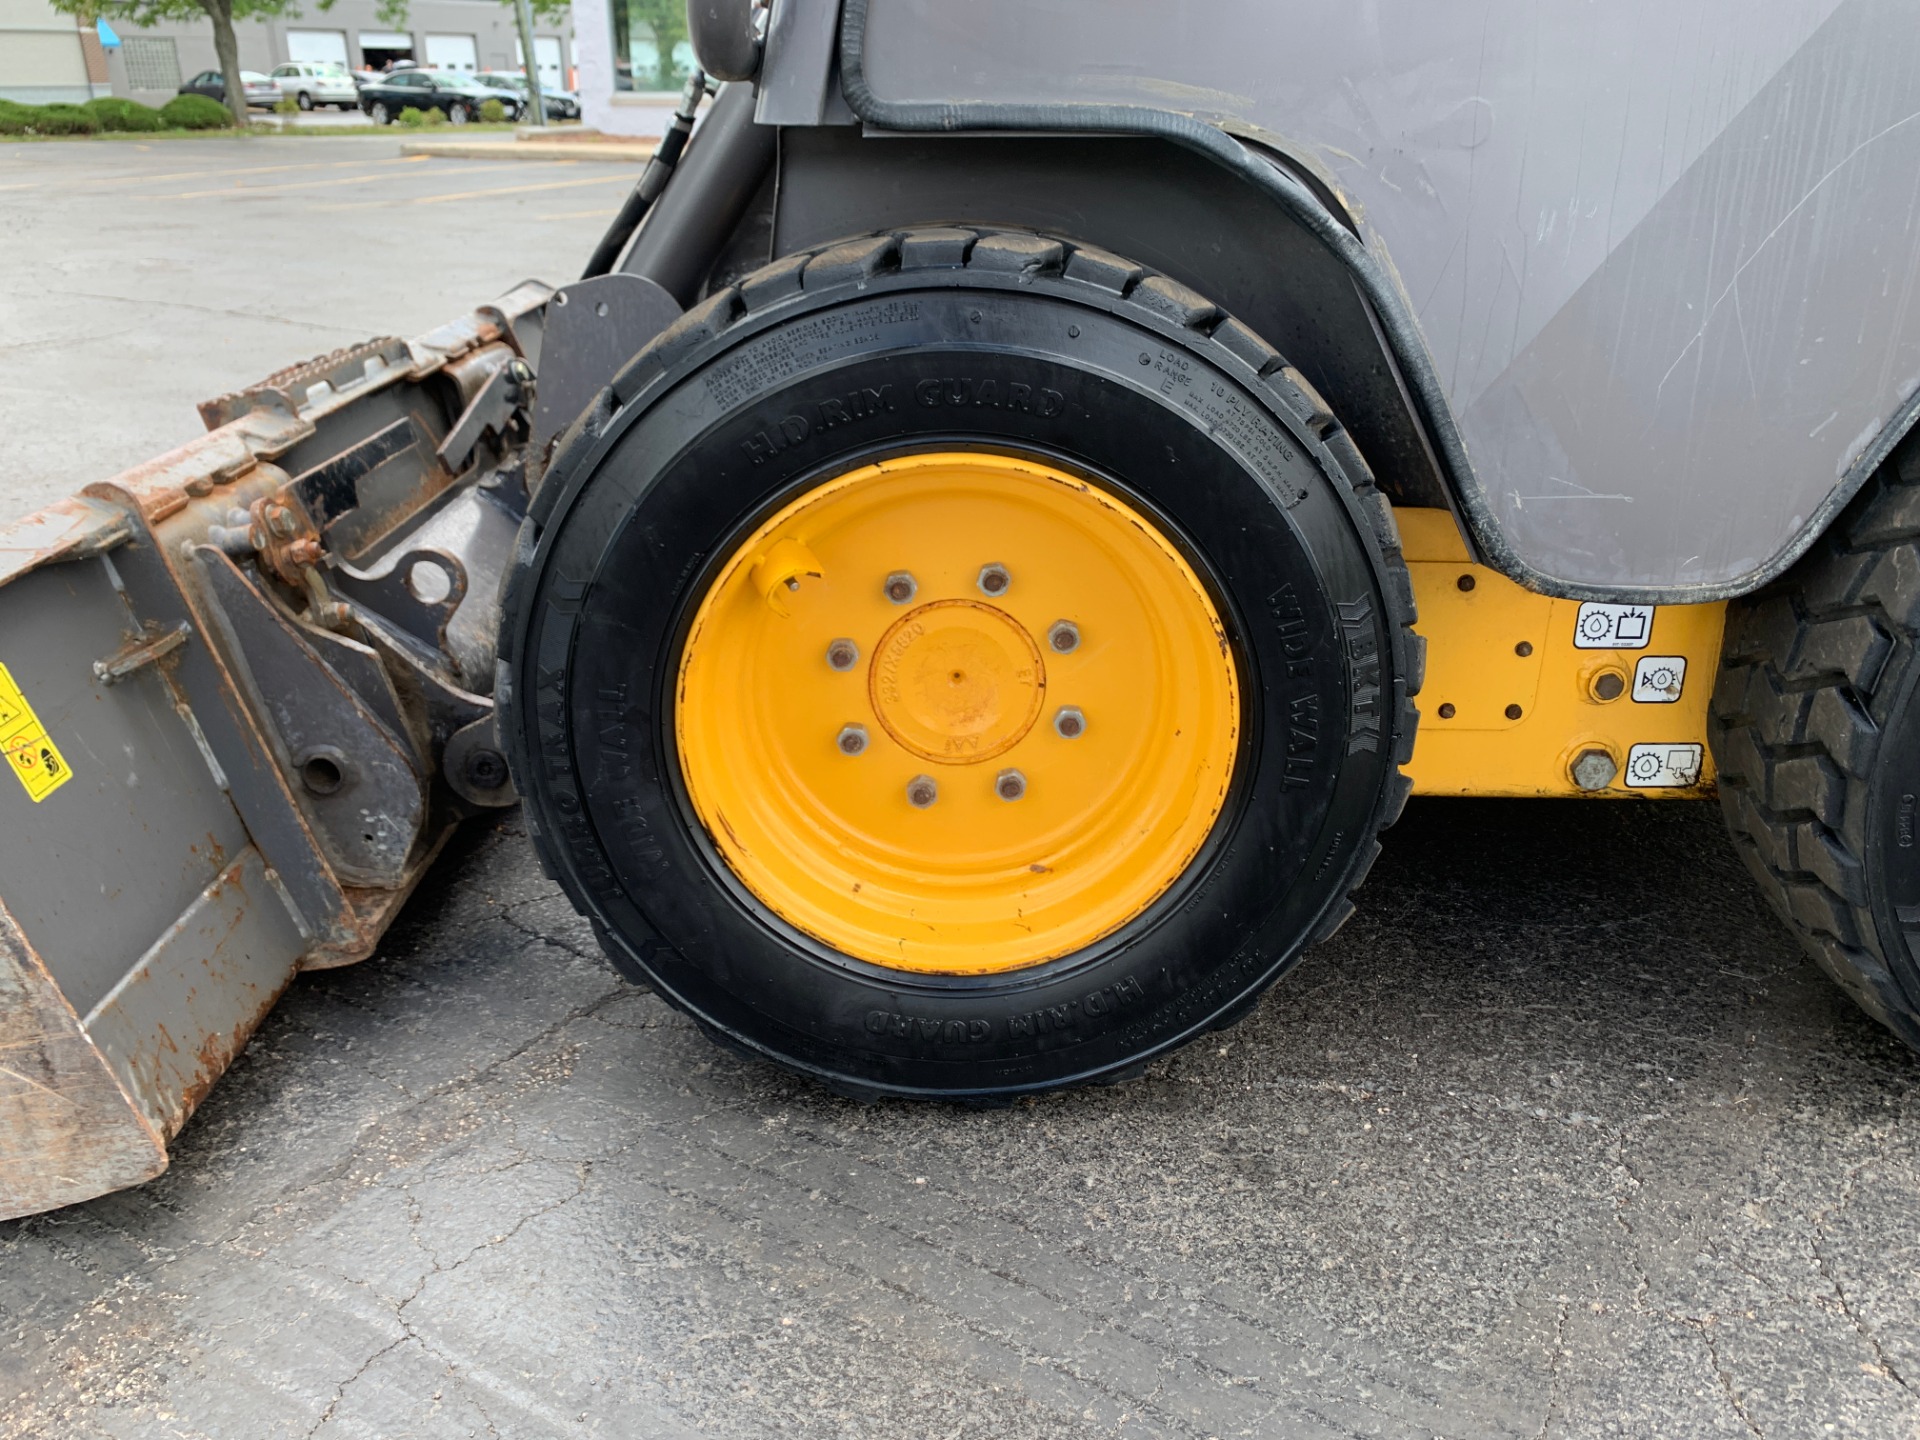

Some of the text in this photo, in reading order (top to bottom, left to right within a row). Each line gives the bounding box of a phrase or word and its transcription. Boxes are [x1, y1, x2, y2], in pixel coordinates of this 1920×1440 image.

[1153, 360, 1192, 387] RANGE
[1159, 349, 1189, 371] LOAD
[915, 377, 1065, 418] GUARD
[1160, 377, 1175, 395] E
[1200, 411, 1218, 425] LOAD
[1205, 404, 1224, 419] LOAD
[1210, 379, 1295, 462] 10 PLY RATING
[1224, 407, 1236, 417] AT
[1253, 433, 1272, 452] COLD
[1266, 582, 1319, 794] WIDE WALL
[1349, 637, 1381, 717] BKT
[537, 664, 568, 782] TRAX
[597, 681, 631, 782] WALL
[863, 1009, 993, 1045] GUARD
